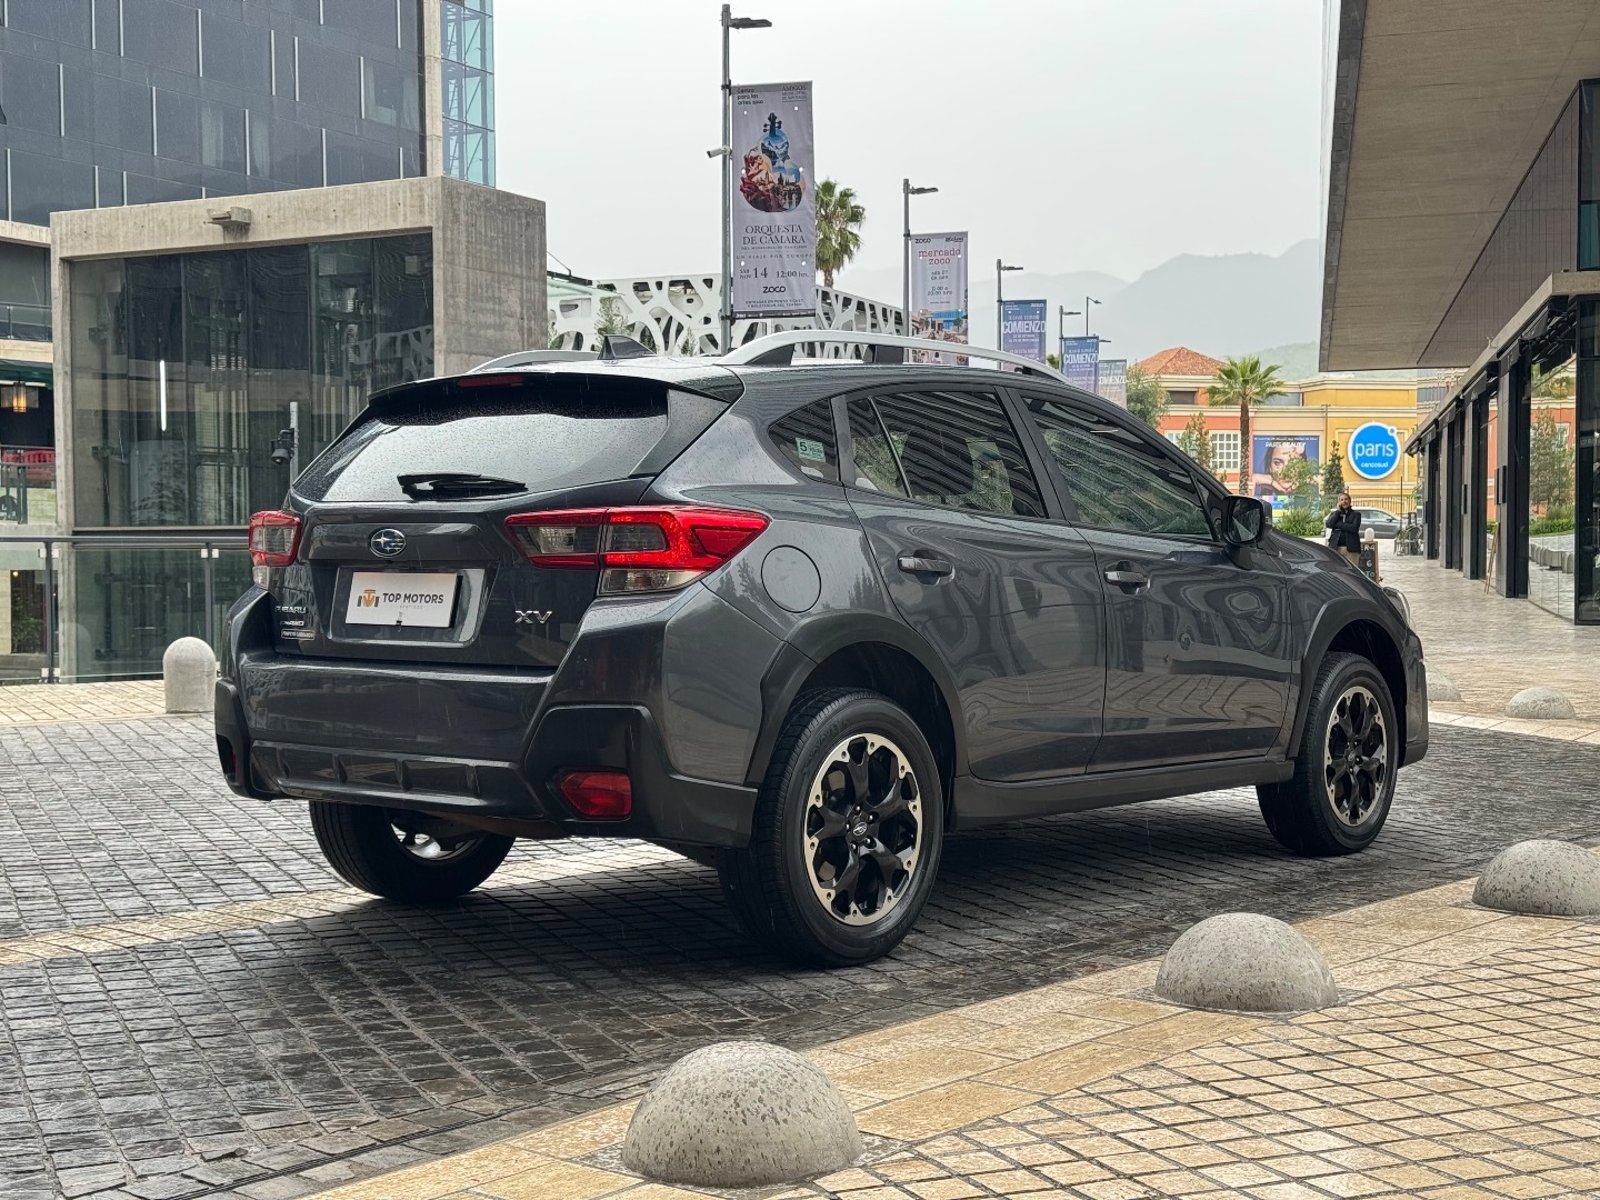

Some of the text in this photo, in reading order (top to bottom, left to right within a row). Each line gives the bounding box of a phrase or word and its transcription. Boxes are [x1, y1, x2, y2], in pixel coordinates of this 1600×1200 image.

[745, 224, 803, 237] ORQUESTA
[743, 236, 758, 246] DE
[919, 248, 961, 258] mercado
[929, 257, 951, 265] zoco
[754, 266, 768, 279] 14
[776, 270, 797, 279] 12:00
[1002, 320, 1047, 334] COMIENZO
[1355, 442, 1394, 460] paris
[1361, 461, 1389, 469] cencosud
[382, 592, 445, 604] TOP MOTORS
[514, 610, 553, 624] XV
